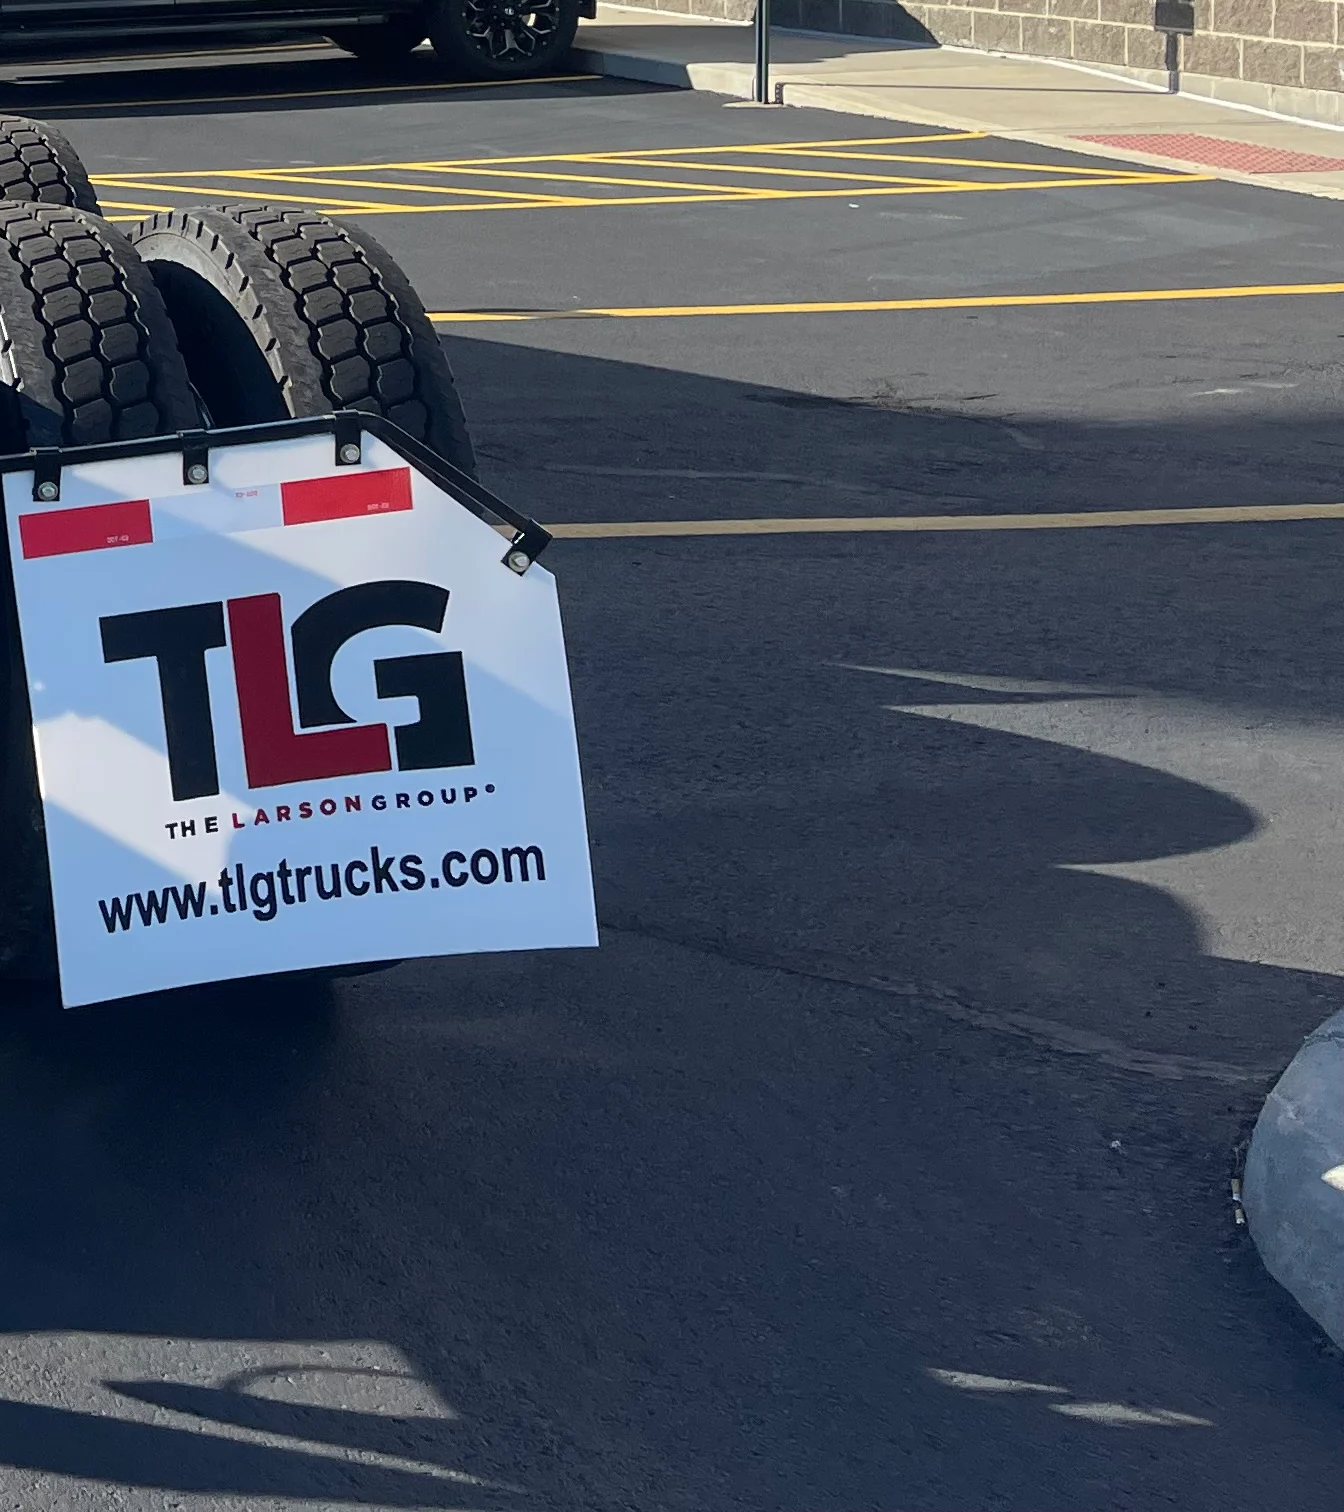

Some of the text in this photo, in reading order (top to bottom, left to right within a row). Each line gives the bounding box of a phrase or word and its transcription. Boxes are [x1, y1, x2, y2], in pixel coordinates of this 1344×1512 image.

[99, 579, 475, 802] TLG
[165, 816, 219, 840] THE
[98, 843, 547, 934] www.tlgtrucks.com
